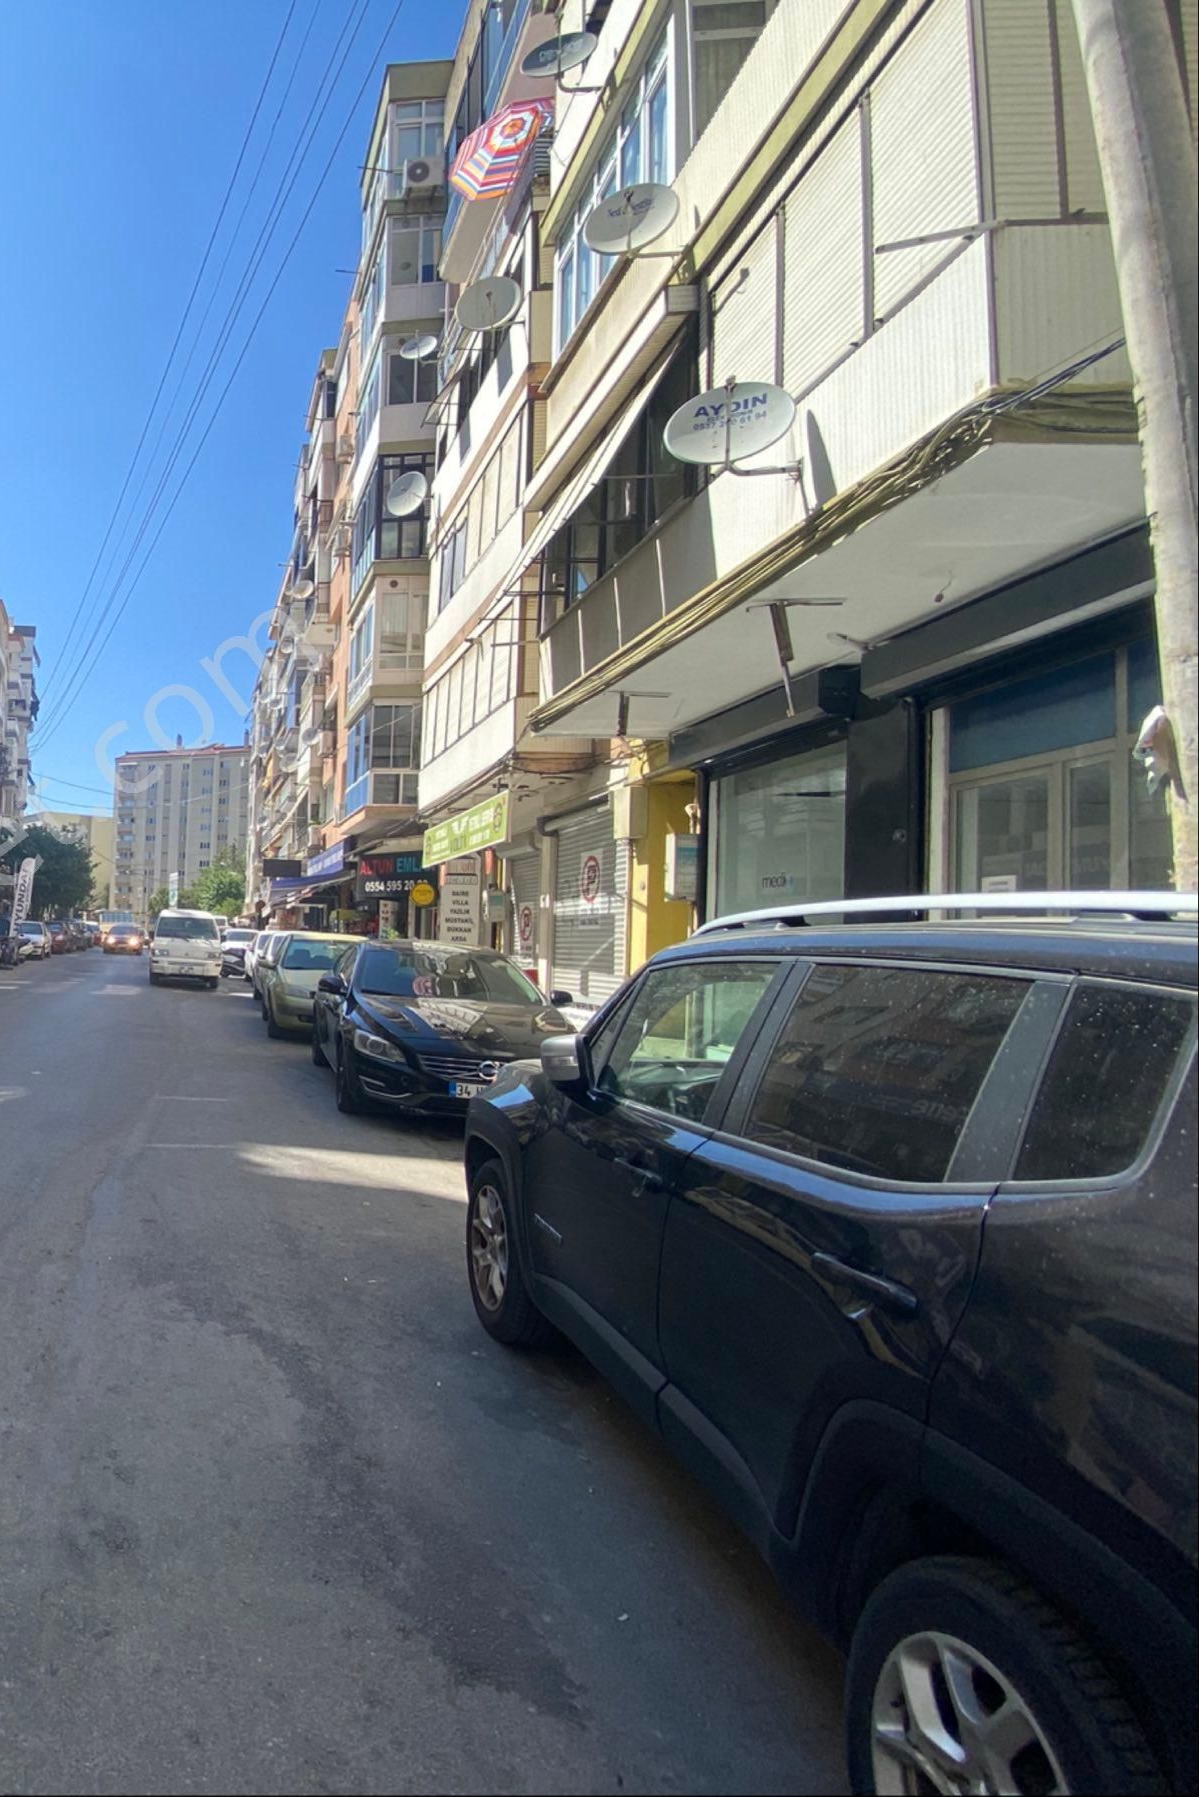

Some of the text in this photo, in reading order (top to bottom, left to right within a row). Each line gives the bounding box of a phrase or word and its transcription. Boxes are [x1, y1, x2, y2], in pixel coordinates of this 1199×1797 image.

[693, 393, 768, 418] AYDIN
[396, 857, 435, 873] EML
[365, 881, 384, 892] 0554
[386, 880, 402, 892] 595
[457, 1085, 471, 1097] 34
